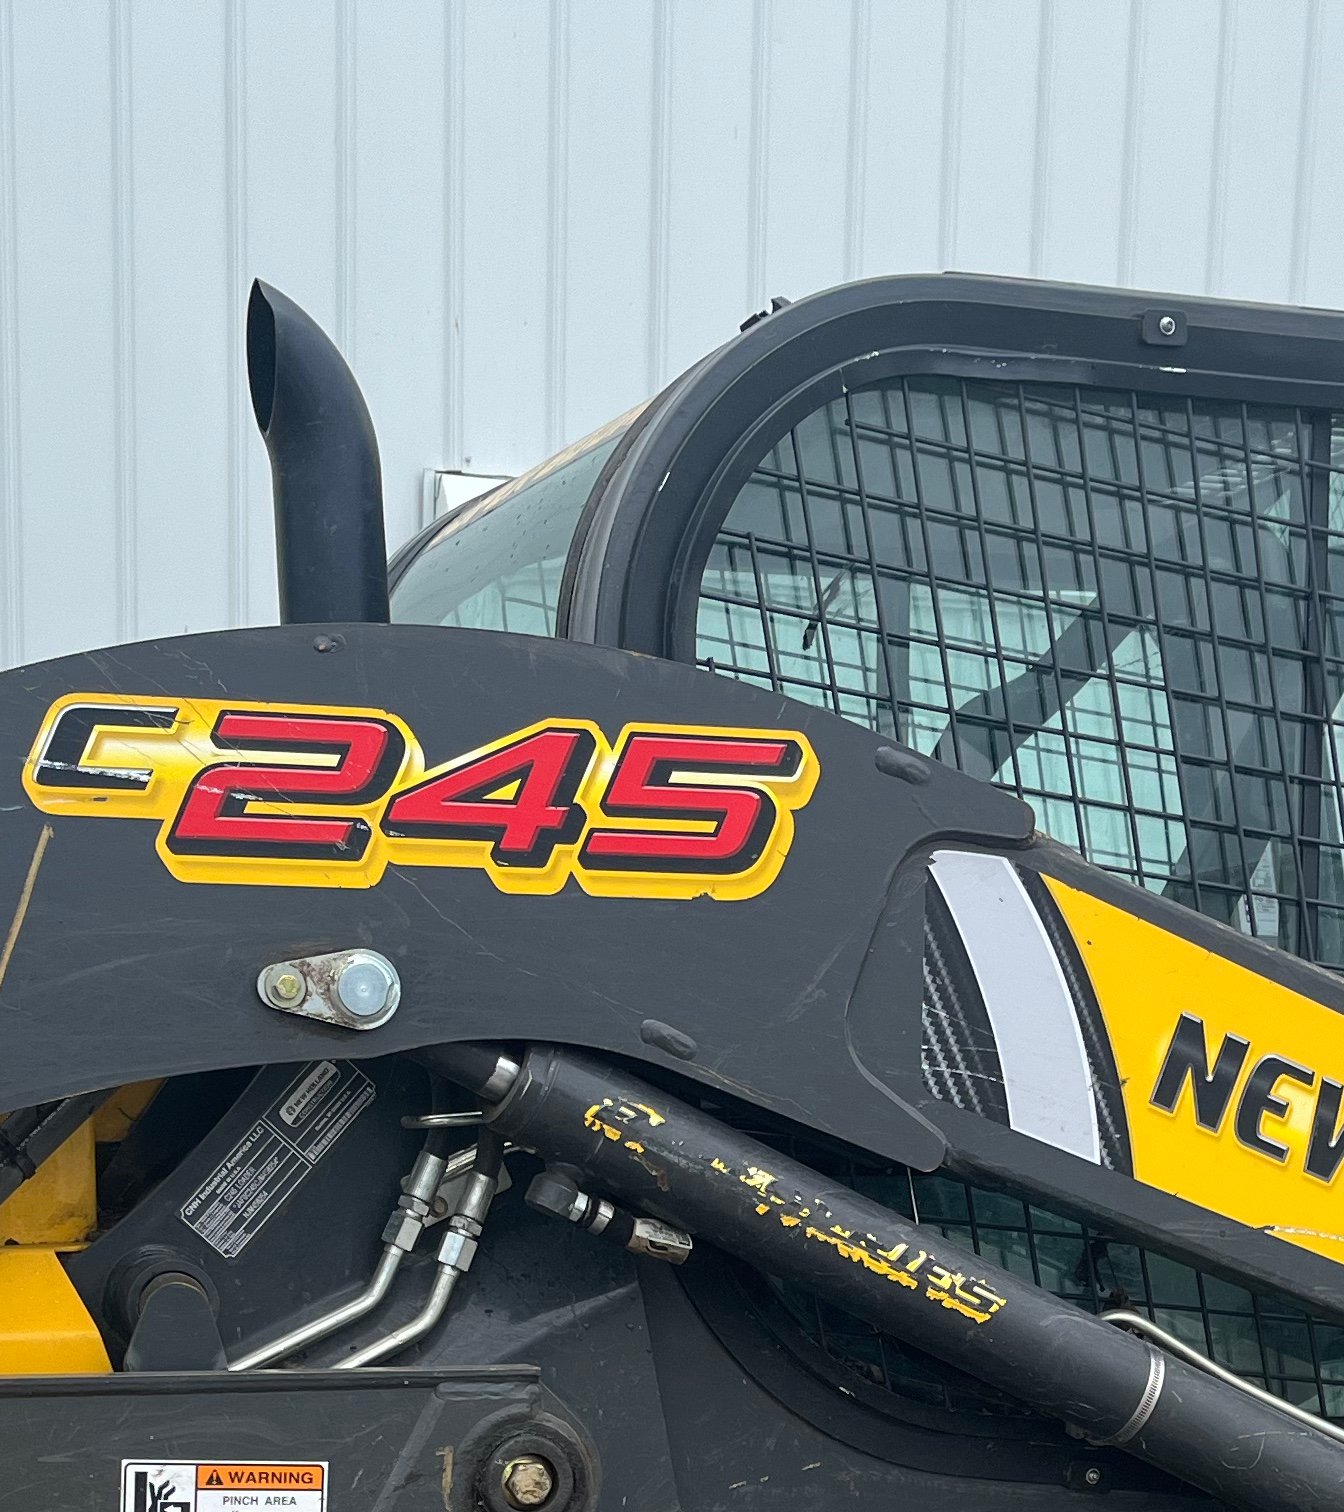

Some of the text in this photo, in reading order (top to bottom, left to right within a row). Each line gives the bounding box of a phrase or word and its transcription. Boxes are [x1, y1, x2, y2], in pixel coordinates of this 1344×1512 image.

[34, 702, 803, 880] C245
[184, 1198, 202, 1217] CNH
[198, 1167, 229, 1200] Industrial
[224, 1140, 253, 1170] America
[248, 1126, 265, 1143] LLC
[223, 1496, 296, 1505] PINCH AREA
[228, 1471, 313, 1484] WARNING
